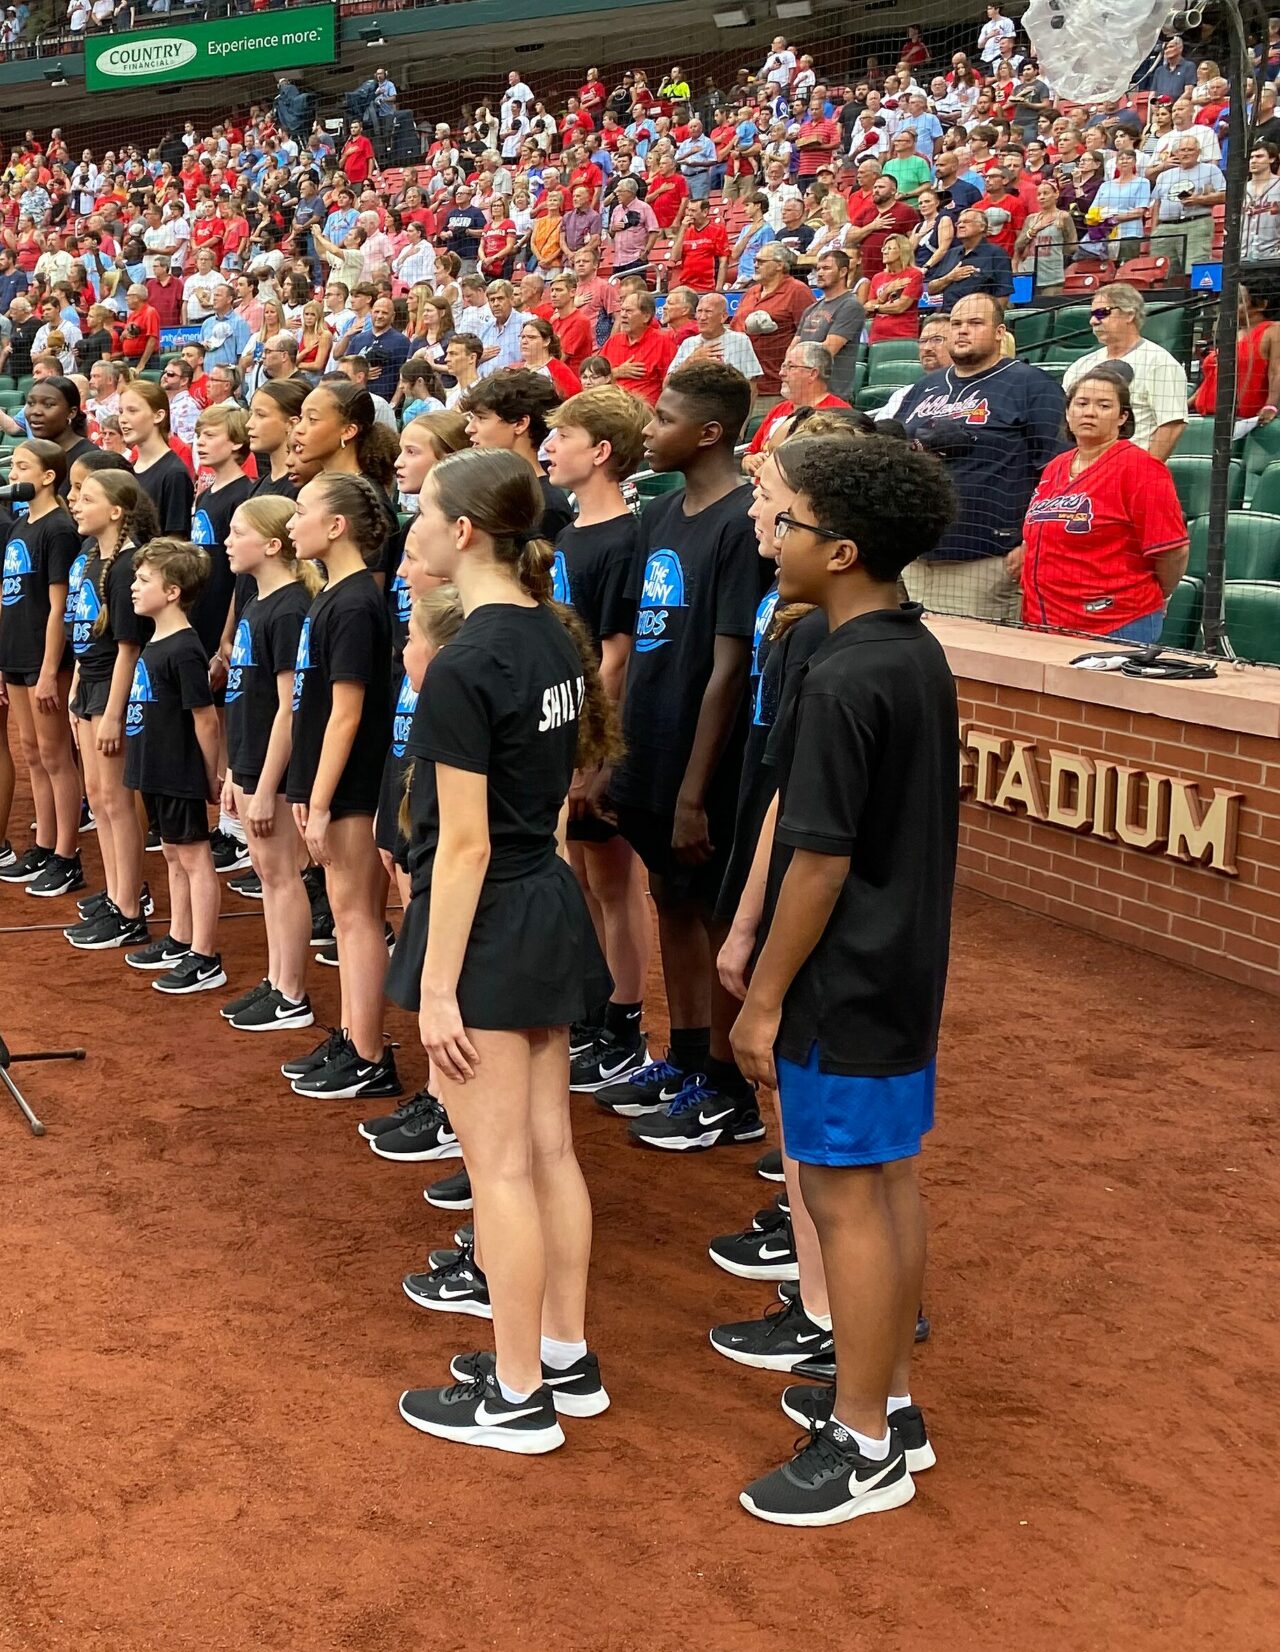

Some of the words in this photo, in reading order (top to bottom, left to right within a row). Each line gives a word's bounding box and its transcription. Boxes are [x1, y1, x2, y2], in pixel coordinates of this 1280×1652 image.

[109, 43, 183, 65] COUNTRY
[208, 36, 278, 57] Experience
[123, 60, 170, 71] FINANCIAL
[651, 561, 670, 584] THE
[641, 580, 674, 605] MUNY
